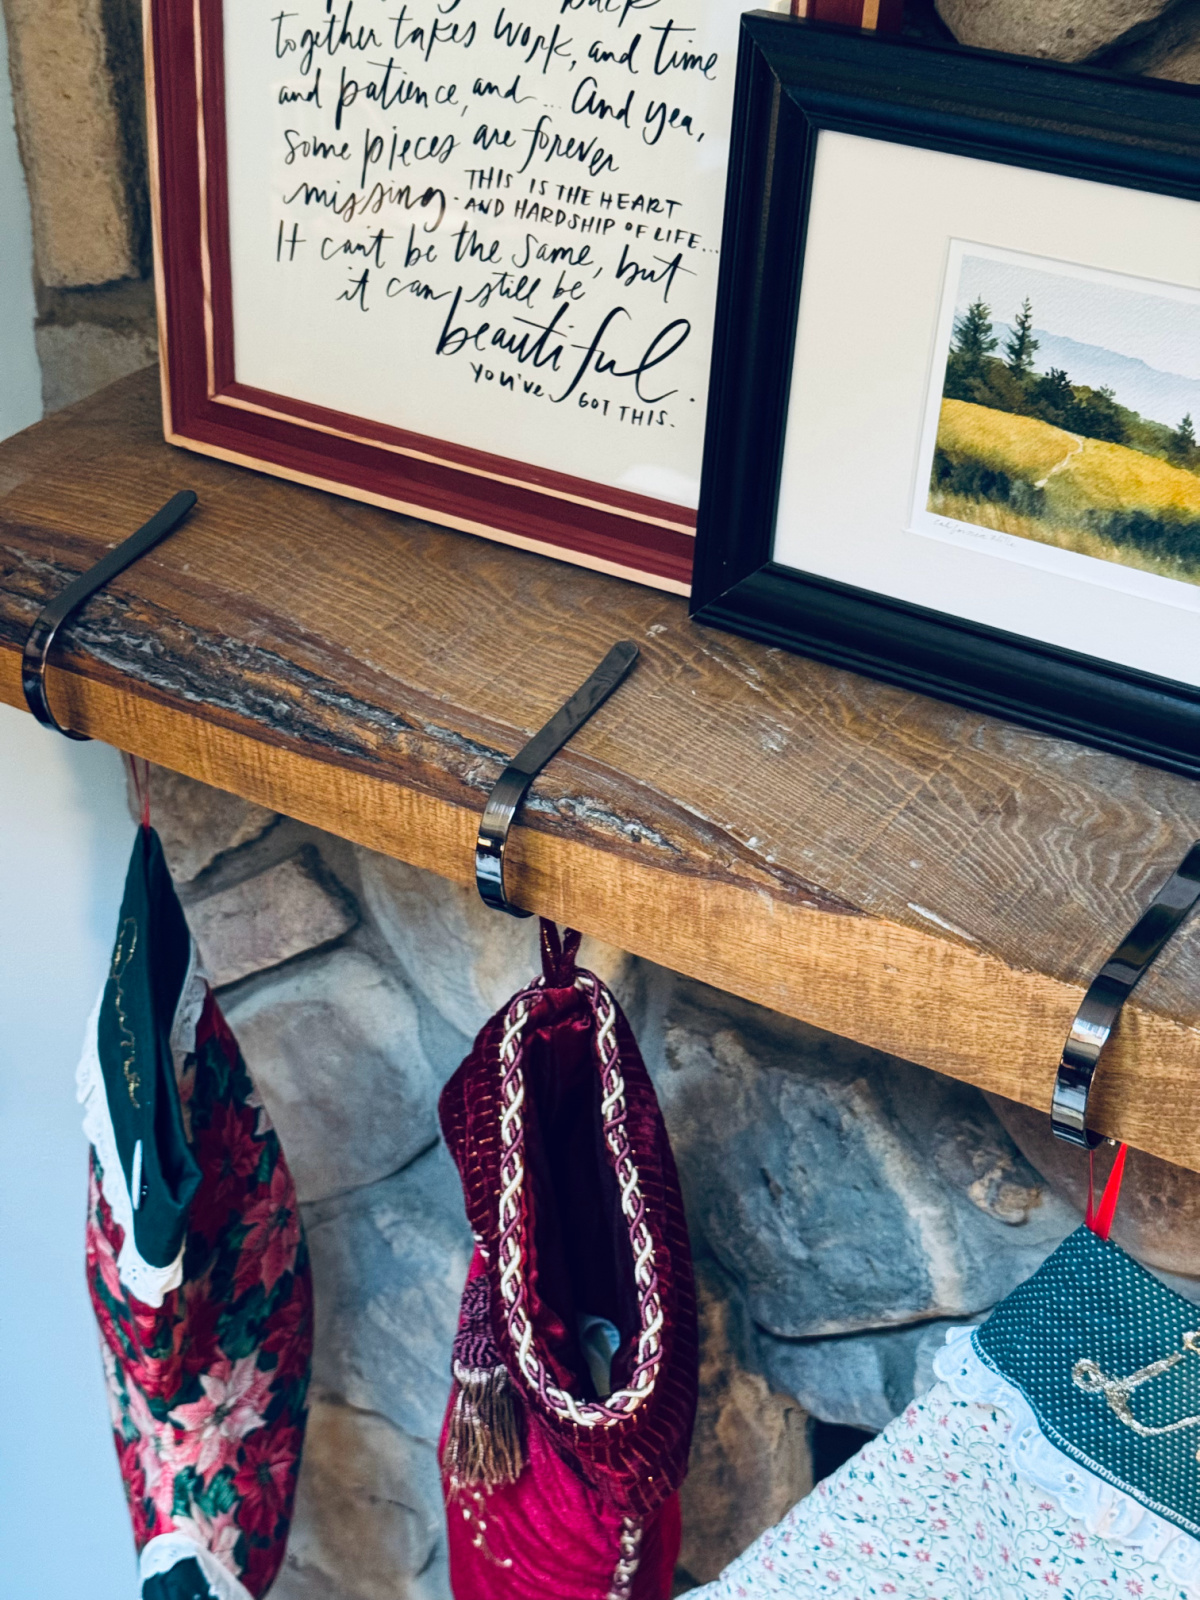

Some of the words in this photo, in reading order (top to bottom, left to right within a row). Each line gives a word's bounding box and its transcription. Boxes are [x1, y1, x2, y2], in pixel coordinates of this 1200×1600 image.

[271, 0, 382, 75] together
[388, 5, 476, 62] takes
[494, 8, 576, 74] work,
[588, 34, 642, 73] and
[650, 19, 718, 80] time
[279, 68, 323, 108] and
[335, 57, 467, 130] patience,
[643, 101, 705, 145] yea,
[361, 126, 461, 189] pieces
[473, 124, 516, 150] are
[516, 115, 619, 176] forever
[283, 180, 459, 232] missing.
[464, 166, 513, 190] THIS
[529, 178, 549, 196] IS
[556, 184, 594, 207] THE
[600, 191, 682, 219] HEART
[464, 197, 505, 217] AND
[514, 199, 616, 236] HARDSHIP
[625, 222, 649, 239] OF
[404, 223, 437, 268] be
[451, 220, 502, 264] the
[615, 244, 697, 303] but
[335, 266, 369, 311] it
[386, 277, 452, 300] can
[465, 271, 541, 308] still
[552, 270, 586, 300] be
[579, 391, 611, 416] GOT
[619, 405, 675, 428] THIS.
